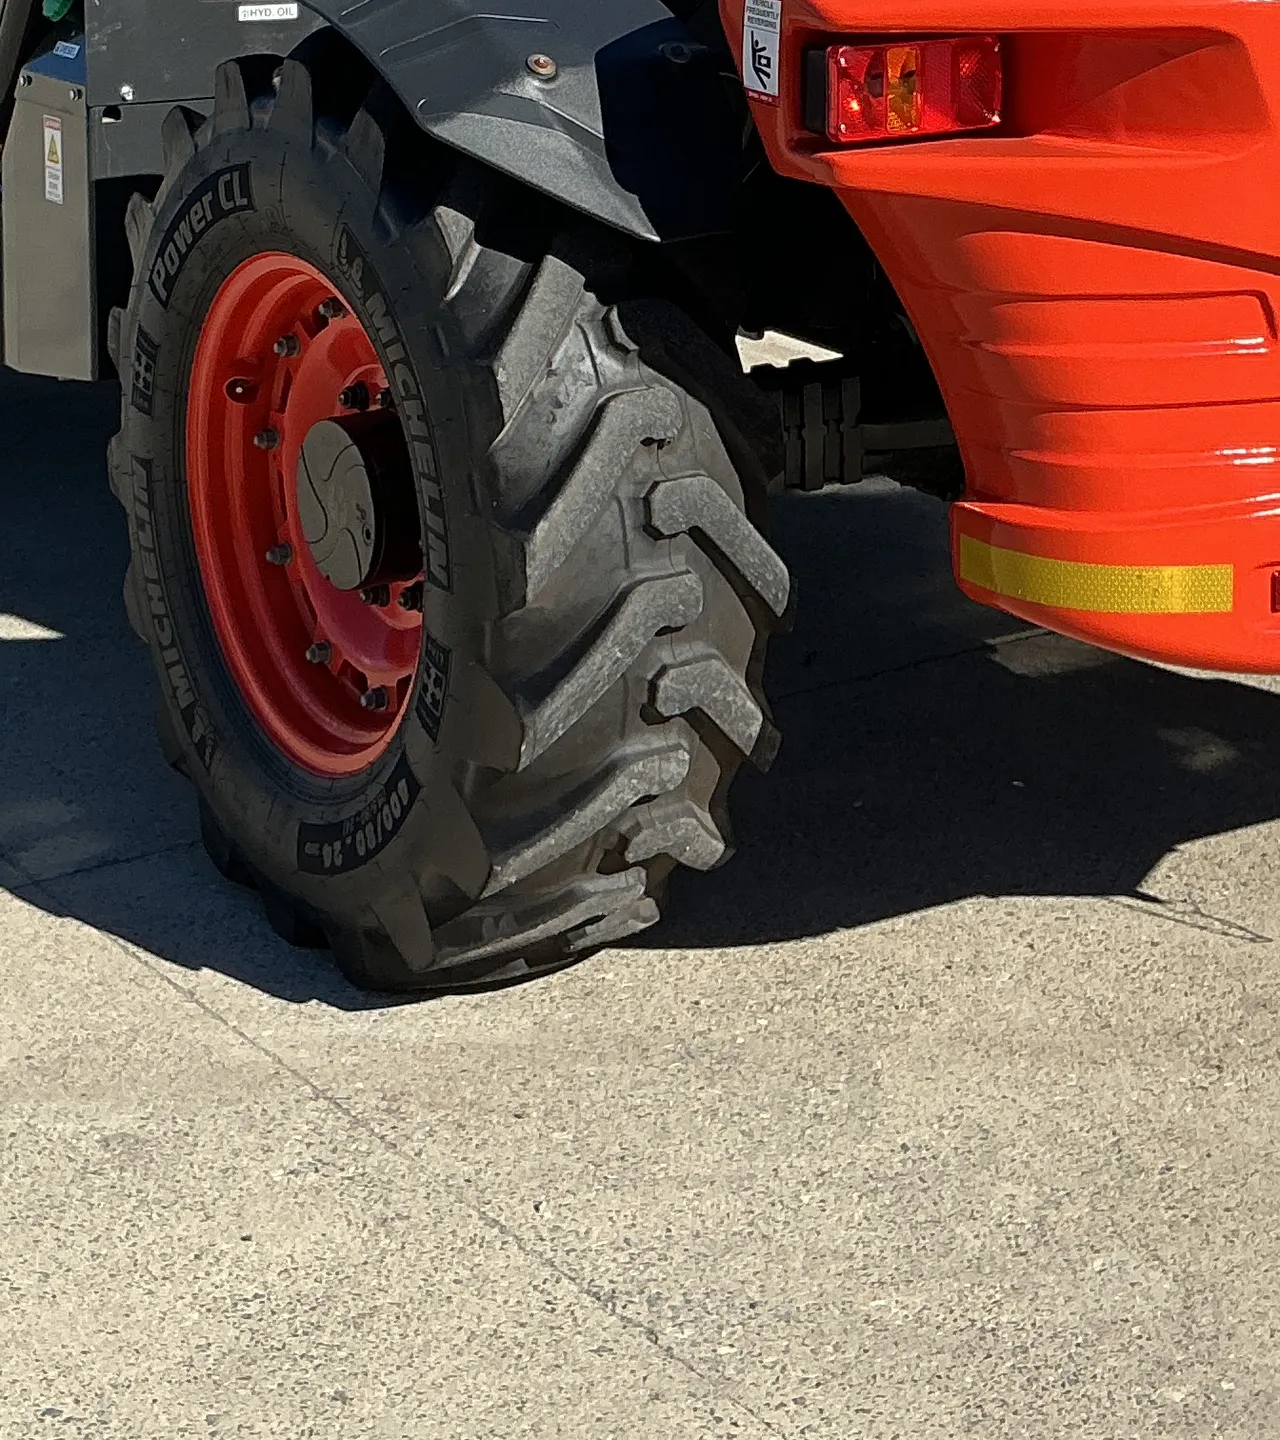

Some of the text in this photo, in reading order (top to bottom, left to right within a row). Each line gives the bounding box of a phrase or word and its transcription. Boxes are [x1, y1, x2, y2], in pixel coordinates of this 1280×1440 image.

[277, 7, 294, 16] OIL
[218, 169, 249, 211] CL
[364, 292, 449, 587] MICHELIN
[131, 459, 195, 710] MICHELIN
